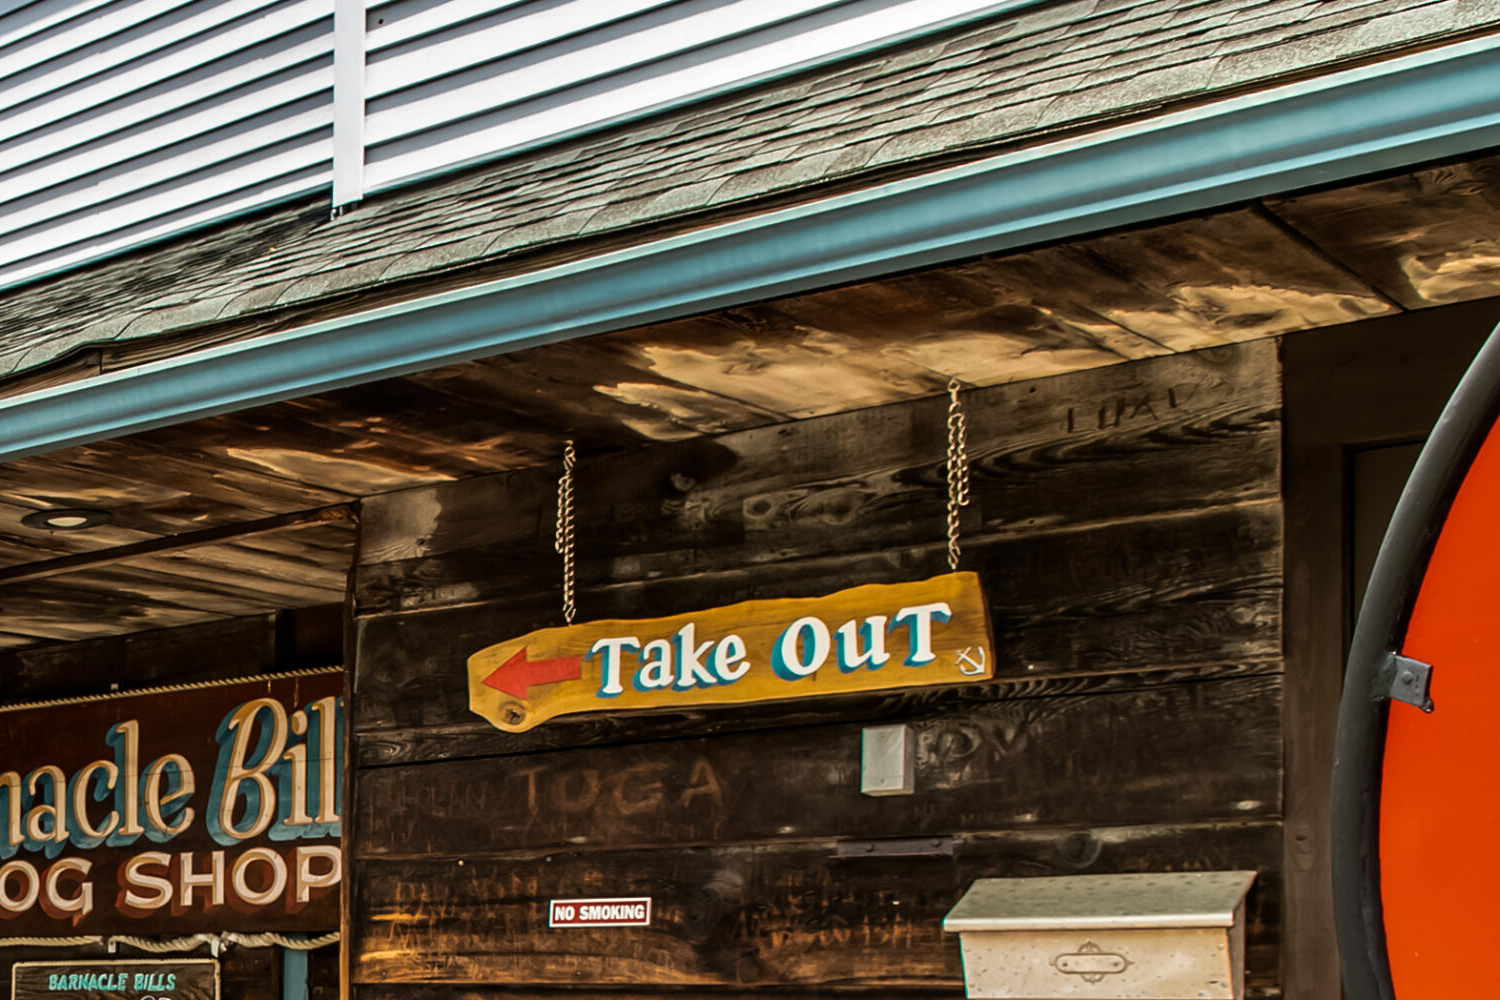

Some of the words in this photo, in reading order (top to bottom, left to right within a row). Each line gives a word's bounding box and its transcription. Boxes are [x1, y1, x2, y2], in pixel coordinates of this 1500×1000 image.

[586, 622, 751, 698] Take
[207, 696, 344, 846] Bil
[120, 845, 342, 914] SHOP
[555, 906, 575, 921] NO
[579, 904, 645, 920] SMOKING
[48, 973, 128, 991] BARNACLE
[134, 973, 176, 991] BILLS
